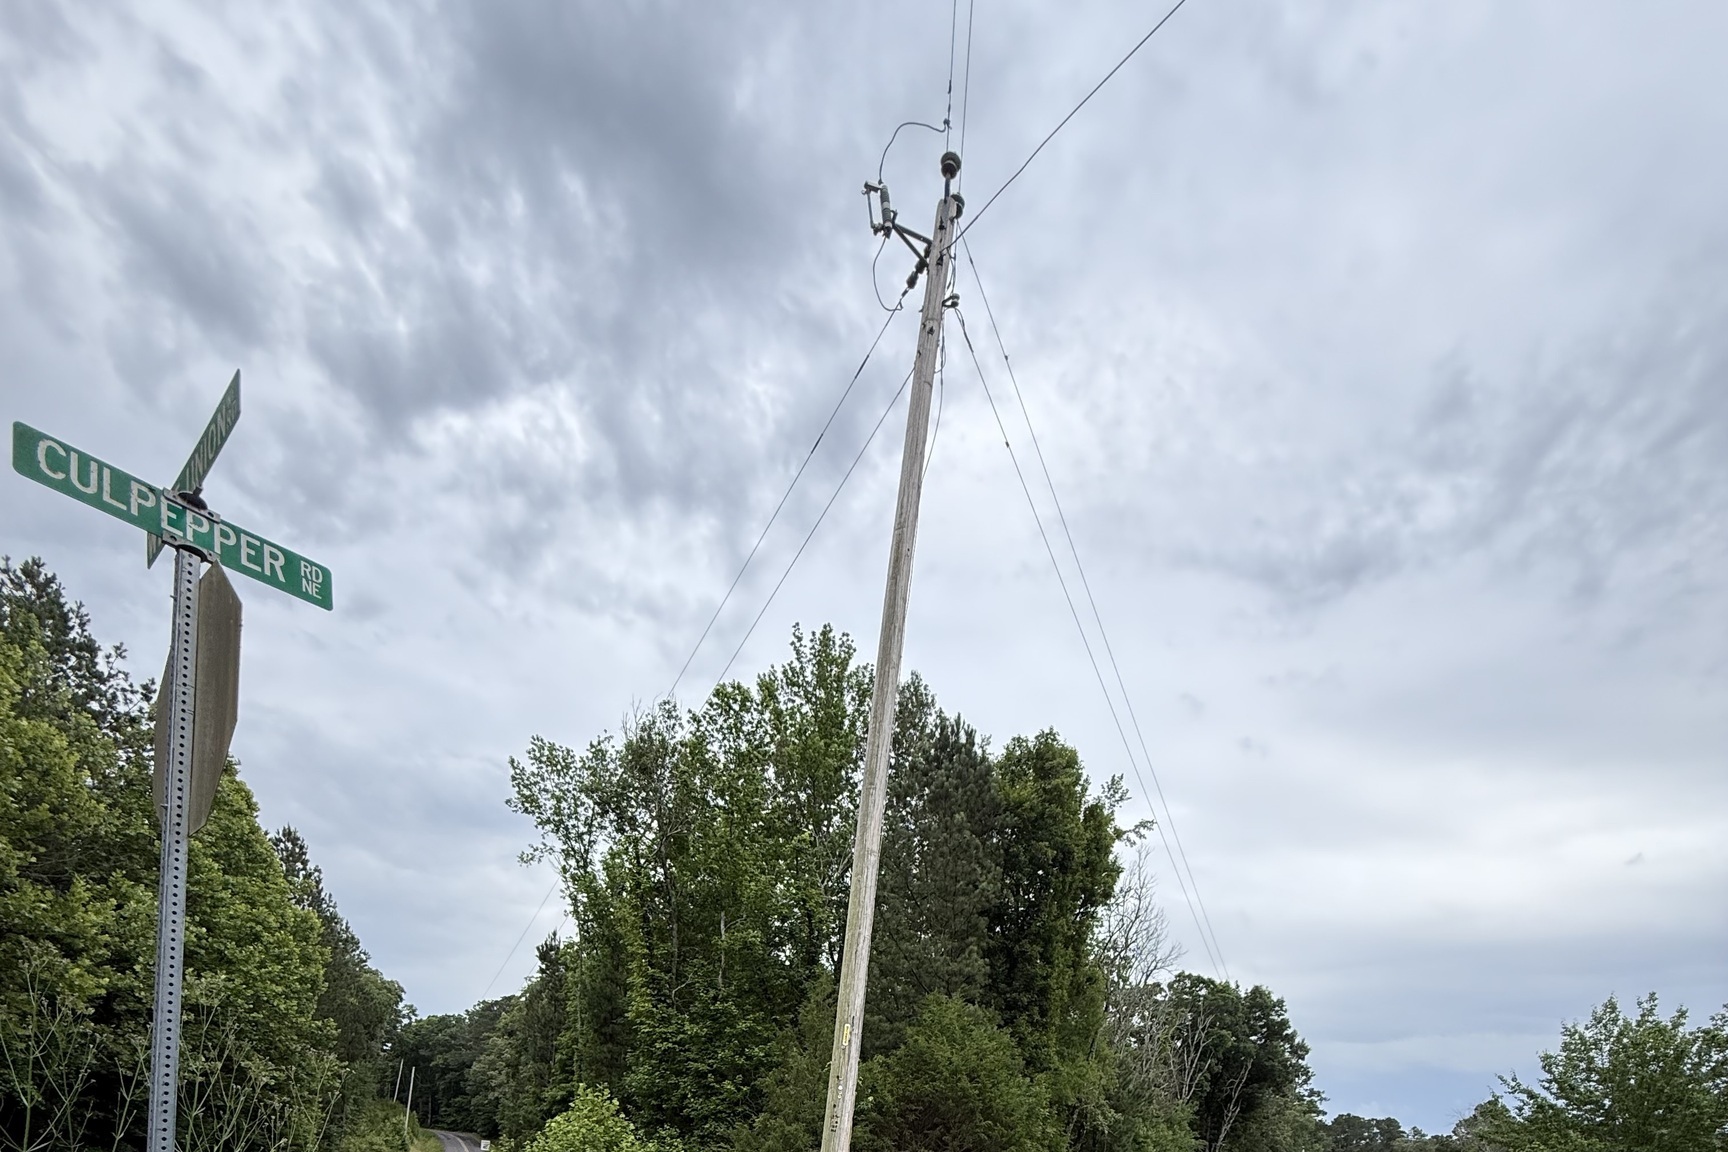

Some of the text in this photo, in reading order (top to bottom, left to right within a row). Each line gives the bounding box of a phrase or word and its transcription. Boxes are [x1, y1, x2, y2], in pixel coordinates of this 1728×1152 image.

[186, 403, 226, 492] UNION
[37, 438, 286, 583] CULPEPPER
[300, 560, 323, 584] RD
[301, 577, 322, 599] NE
